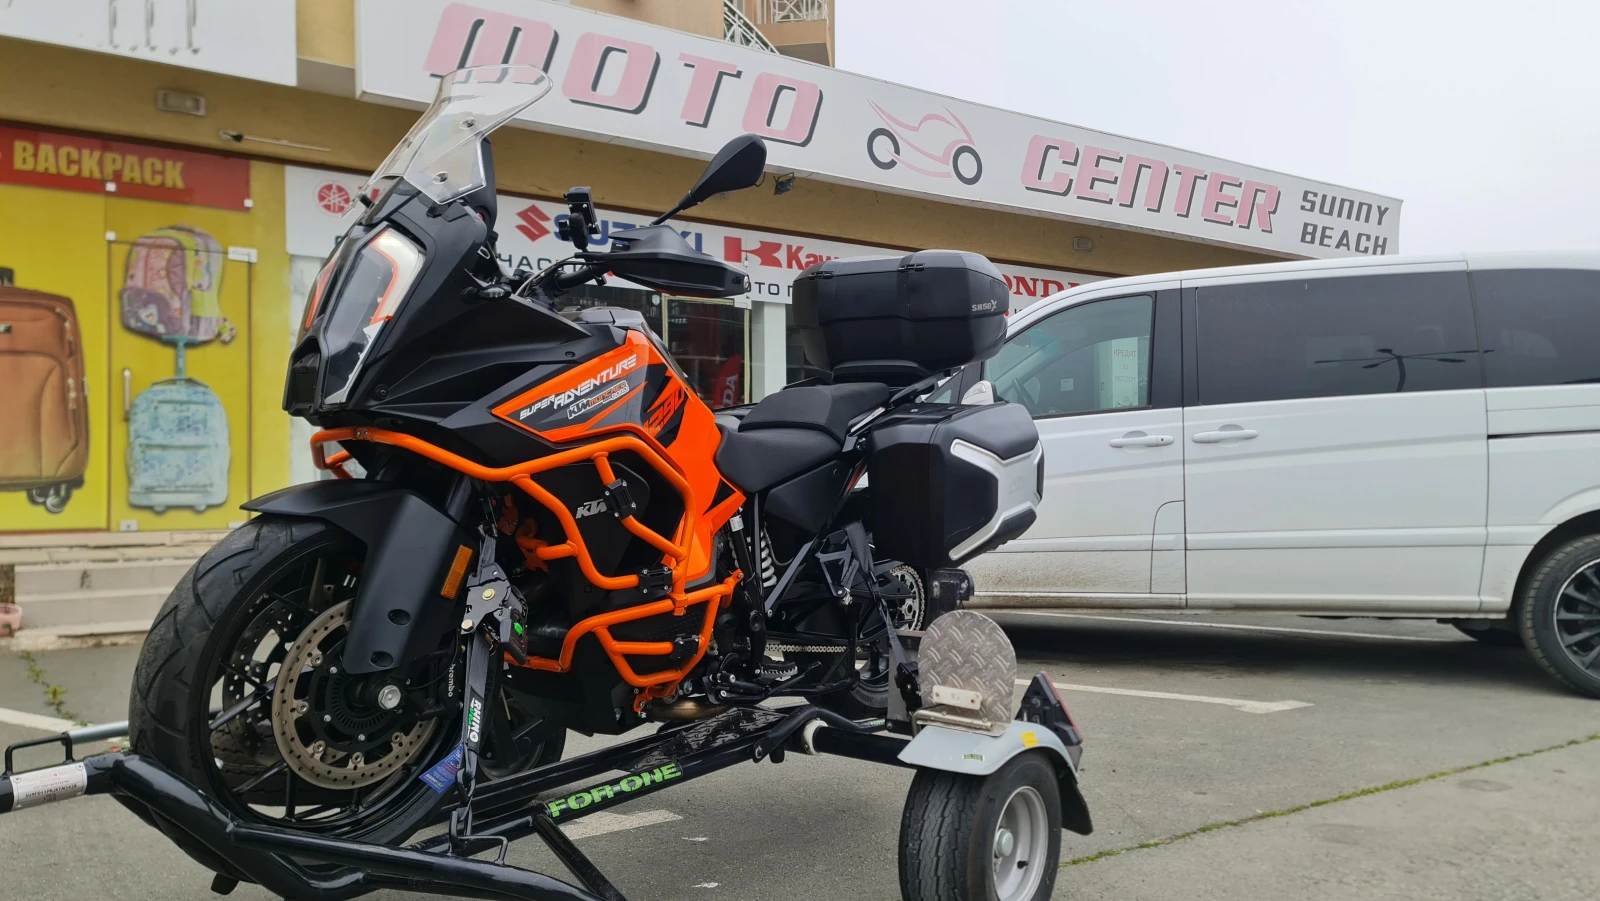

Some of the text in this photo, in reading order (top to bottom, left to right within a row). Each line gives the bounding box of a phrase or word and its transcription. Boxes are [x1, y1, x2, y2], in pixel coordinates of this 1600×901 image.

[423, 2, 823, 147] MOTO
[13, 140, 185, 190] BACKPACK
[1021, 135, 1281, 233] CENTER
[1300, 190, 1389, 226] SUNNY
[1300, 222, 1388, 255] BEACH
[519, 354, 637, 420] SUPER ADVENTURE
[548, 762, 682, 818] FOR-ONE
